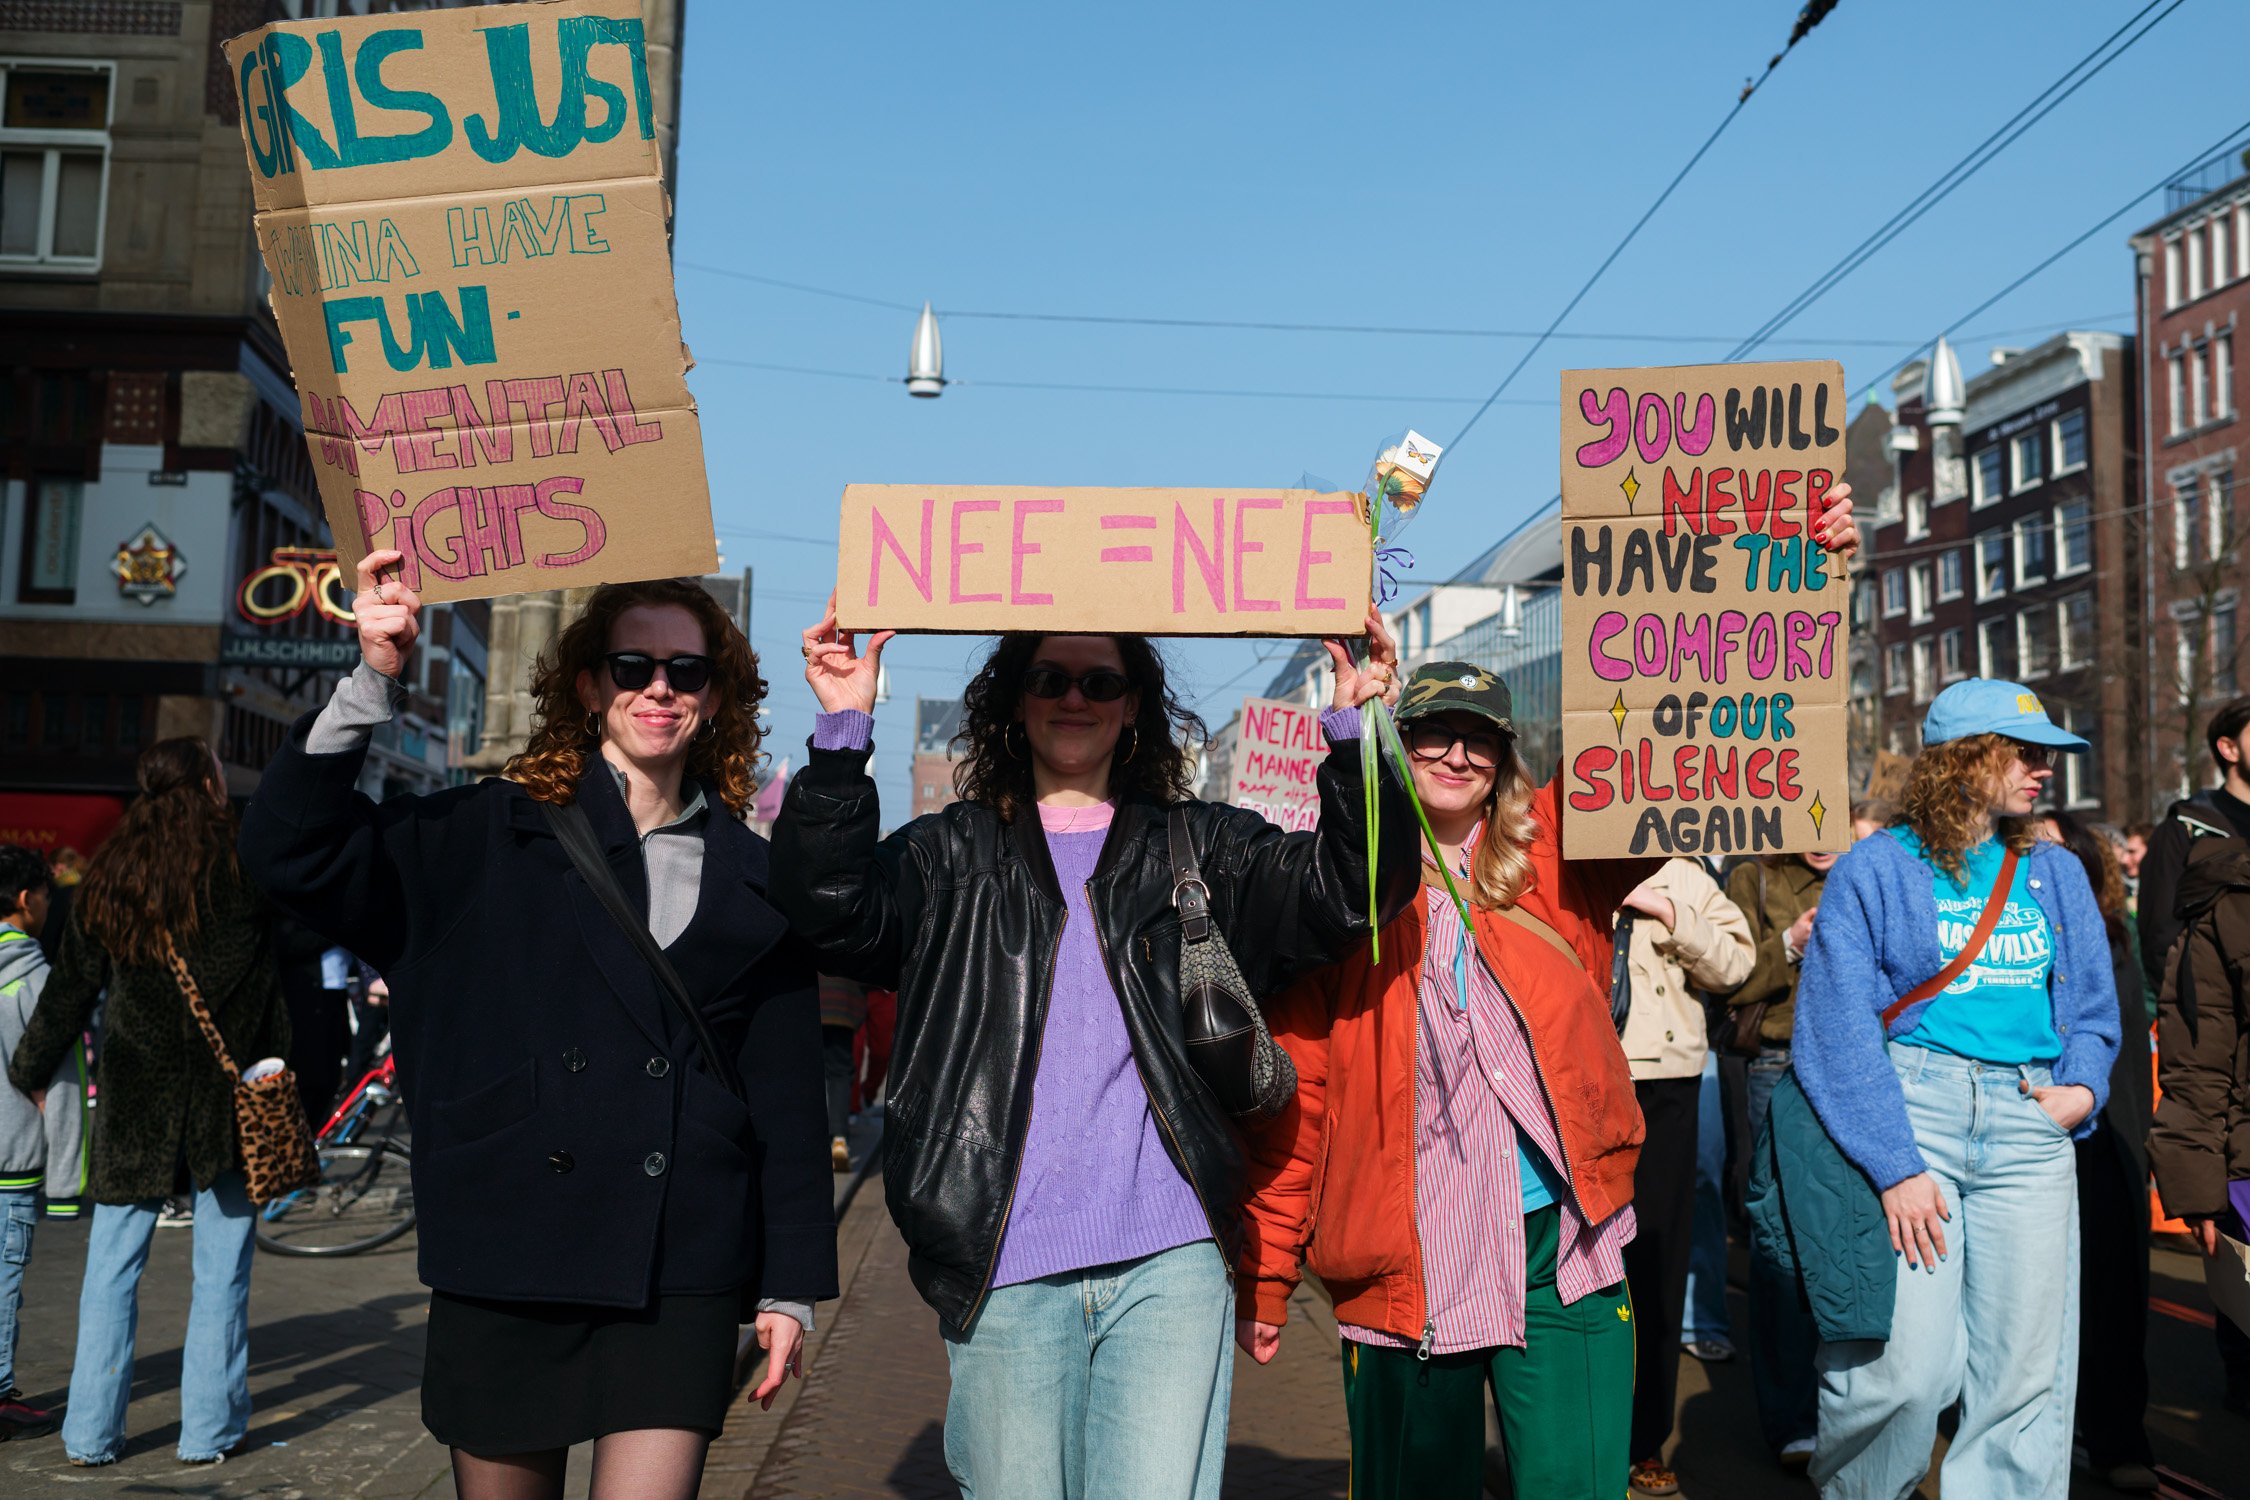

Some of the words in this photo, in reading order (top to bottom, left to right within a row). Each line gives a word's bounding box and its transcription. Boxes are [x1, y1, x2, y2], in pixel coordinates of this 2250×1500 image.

[463, 15, 656, 164] JUST
[270, 218, 421, 297] WANNA
[447, 193, 611, 268] HAVE
[308, 368, 663, 478] DAMENTAL
[1576, 386, 1716, 468] YOU
[1725, 382, 1840, 451] WILL
[1662, 466, 1834, 540] NEVER
[868, 499, 1064, 606] NEE
[1172, 497, 1354, 613] NEE
[1571, 526, 1722, 597] HAVE
[1734, 533, 1828, 594] THE
[1589, 610, 1842, 684] COMFORT
[1652, 692, 1709, 740] OF
[1710, 692, 1795, 741] OUR
[1569, 737, 1804, 813] SILENCE
[1629, 806, 1784, 856] AGAIN
[1938, 920, 2049, 965] NASVILLE
